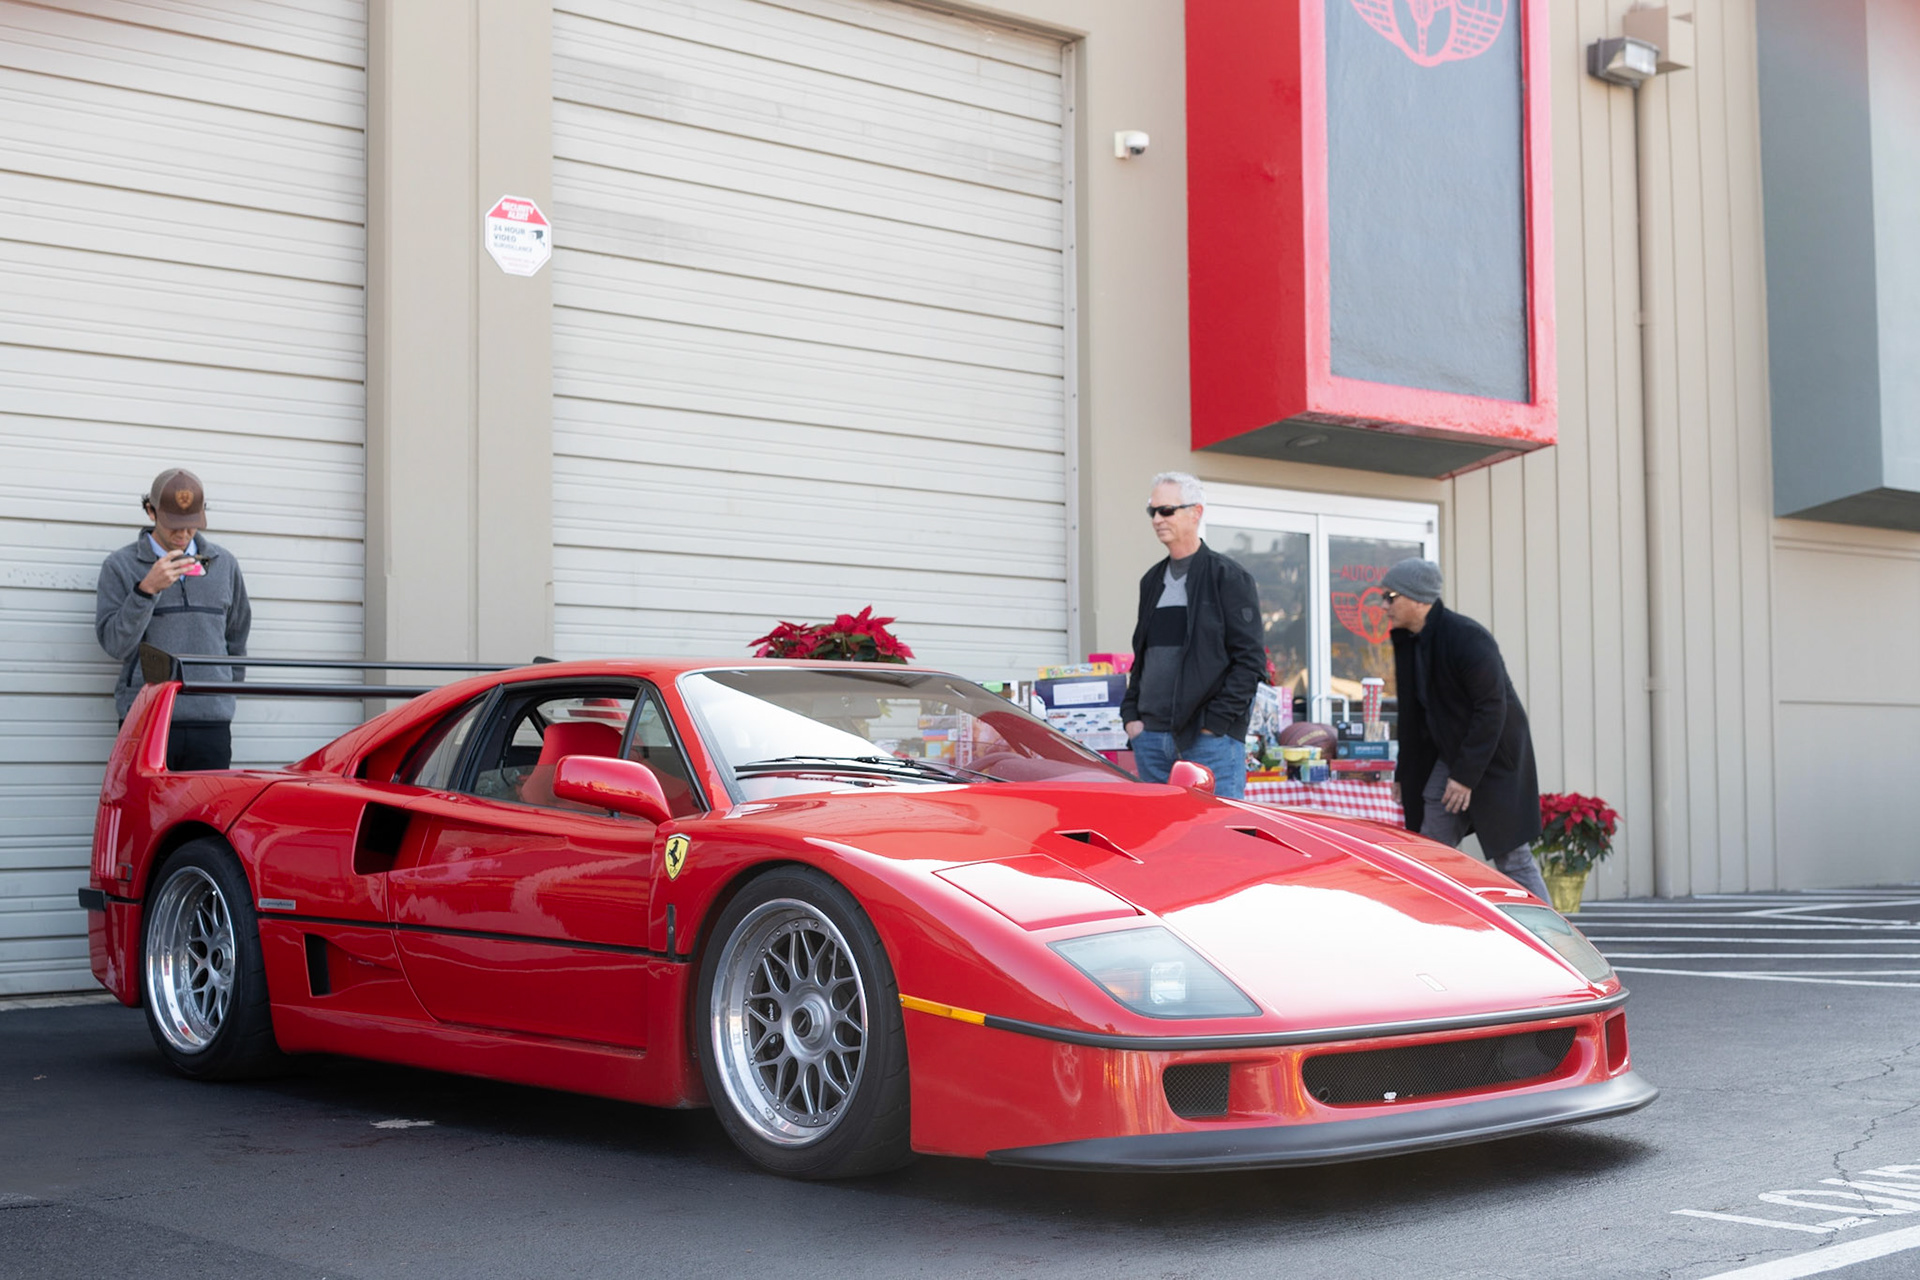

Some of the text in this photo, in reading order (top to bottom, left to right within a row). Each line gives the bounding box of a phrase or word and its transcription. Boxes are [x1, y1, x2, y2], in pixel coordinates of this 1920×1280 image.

[504, 226, 525, 236] HOUR
[494, 233, 517, 242] VIDEO
[1340, 564, 1389, 582] AUTOV
